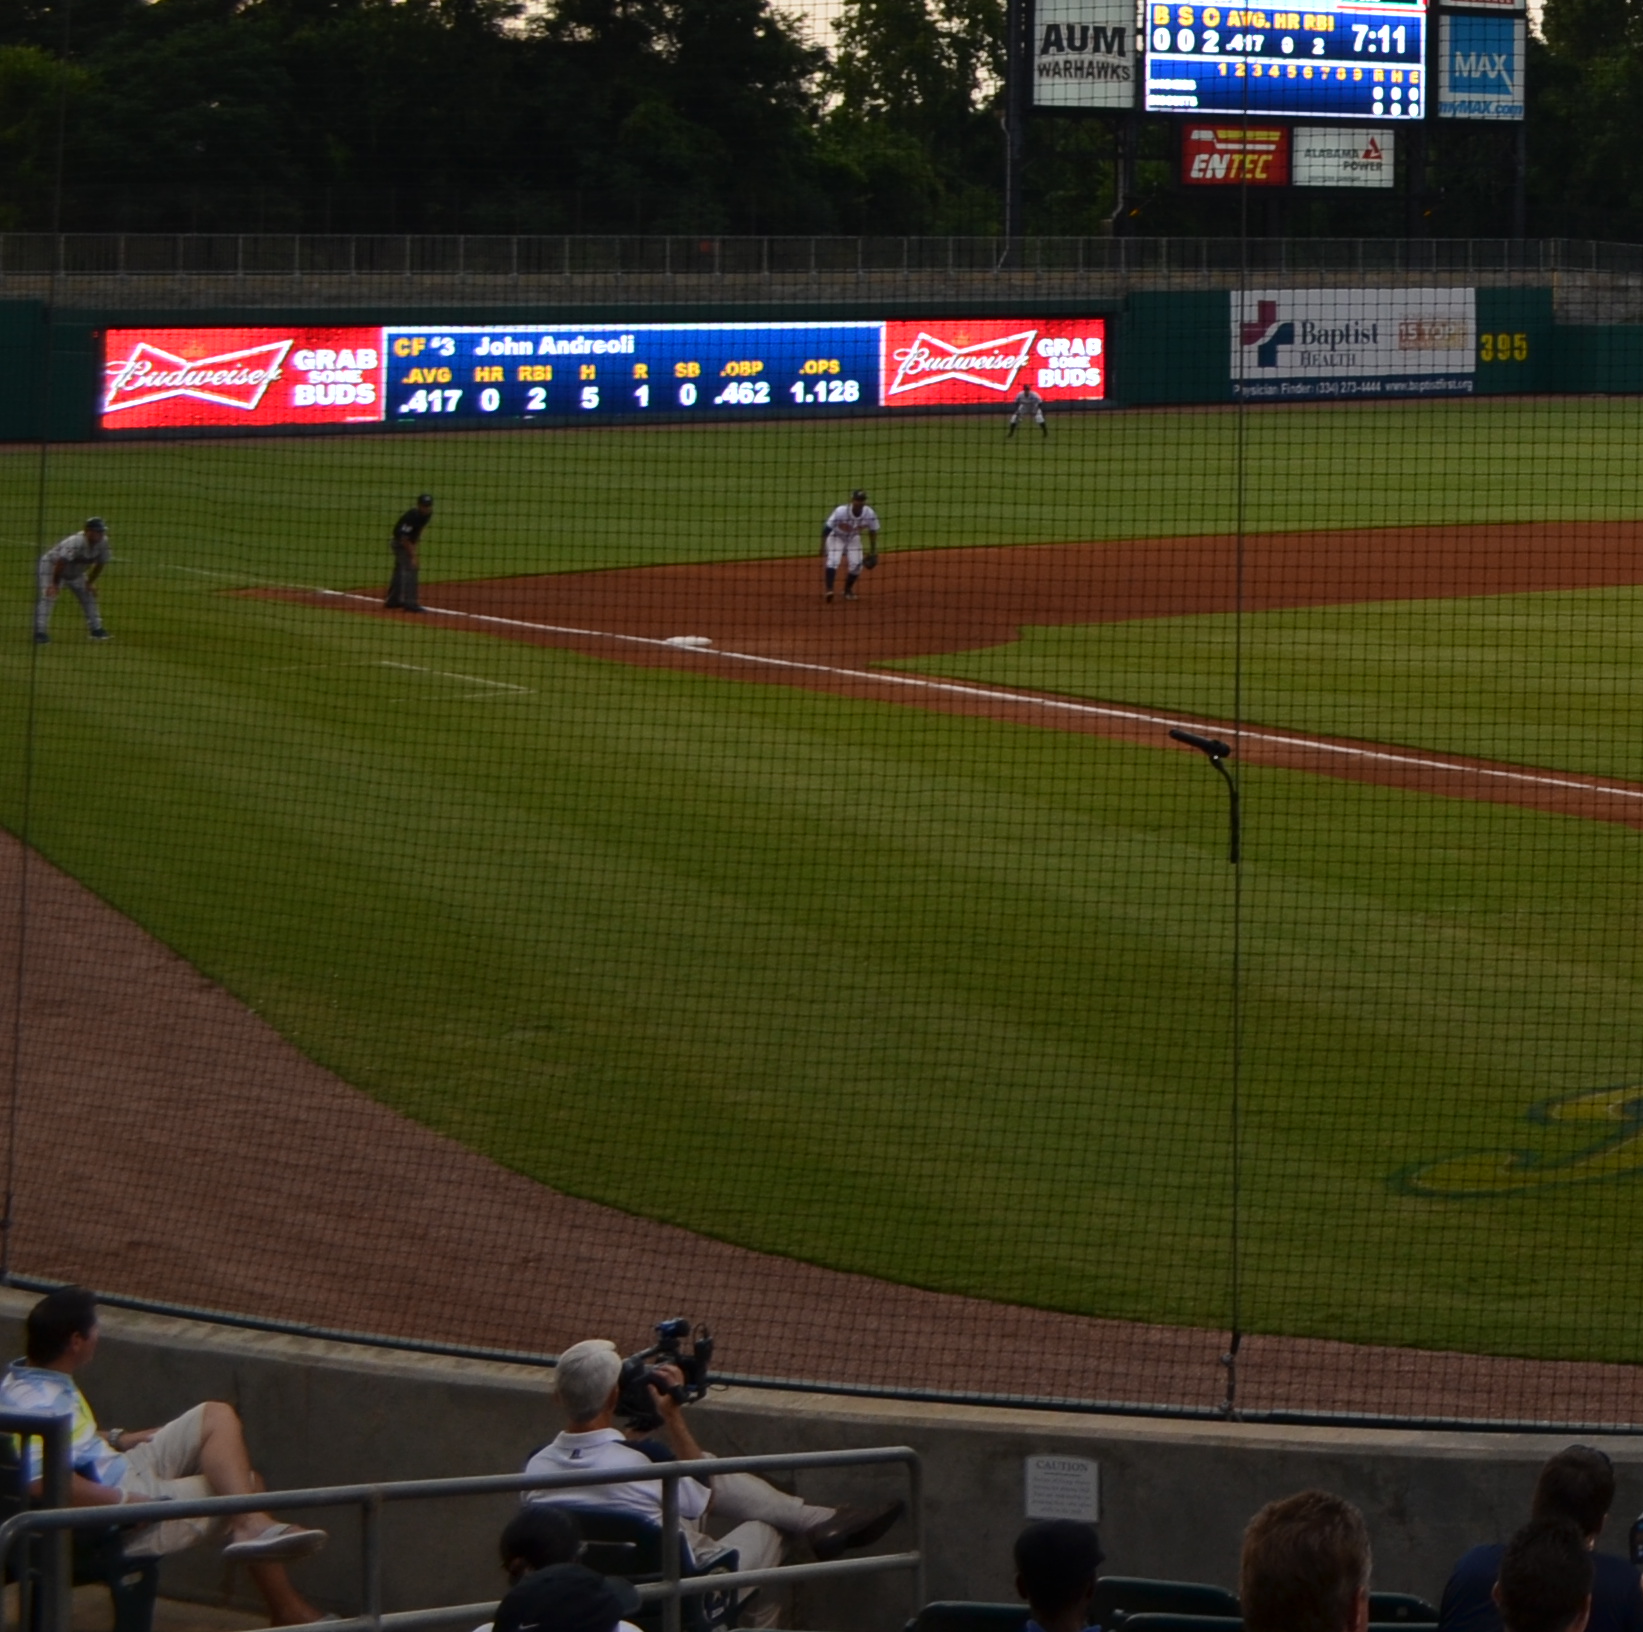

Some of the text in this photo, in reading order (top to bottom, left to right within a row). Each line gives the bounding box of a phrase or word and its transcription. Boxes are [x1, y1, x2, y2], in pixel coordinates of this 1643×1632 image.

[1154, 5, 1335, 32] B S O AVG. HR RBI
[1041, 23, 1127, 57] AUM
[1153, 27, 1171, 51] 0
[1177, 28, 1196, 52] 0
[1202, 30, 1220, 53] 2
[1225, 34, 1265, 52] .417
[1311, 38, 1324, 55] 2
[1351, 23, 1406, 54] 7:11
[1037, 60, 1131, 82] WARHAWKS
[1218, 63, 1419, 84] 1 2 3 4 5 6 7 8 9 R H E
[1455, 52, 1513, 95] MAX
[1439, 100, 1524, 117] myMAX.com
[1304, 149, 1359, 159] ALABAMA
[1190, 153, 1273, 179] ENTEC
[1343, 161, 1383, 171] POWER
[1301, 321, 1379, 350] Baptist
[1399, 324, 1455, 340] 15 TOP
[394, 337, 427, 358] CF
[475, 336, 534, 356] John
[538, 334, 635, 355] Andreoli
[1036, 338, 1103, 358] GRAB
[1480, 333, 1528, 362] 395
[293, 349, 379, 370] GRAB
[893, 348, 1029, 375] Budweiser
[1048, 356, 1090, 369] SOME
[1300, 353, 1356, 367] HEALTH
[105, 360, 284, 391] Budweiser
[308, 370, 363, 384] SOME
[402, 359, 841, 384] .AVG HR RBI H R SB .OBP .OPS
[1037, 368, 1101, 388] BUDS
[293, 384, 376, 407] BUDS
[398, 380, 860, 413] .417 0 2 5 1 0 .462 1.128
[1233, 382, 1279, 398] Pysician
[1036, 1460, 1089, 1472] CAUTION
